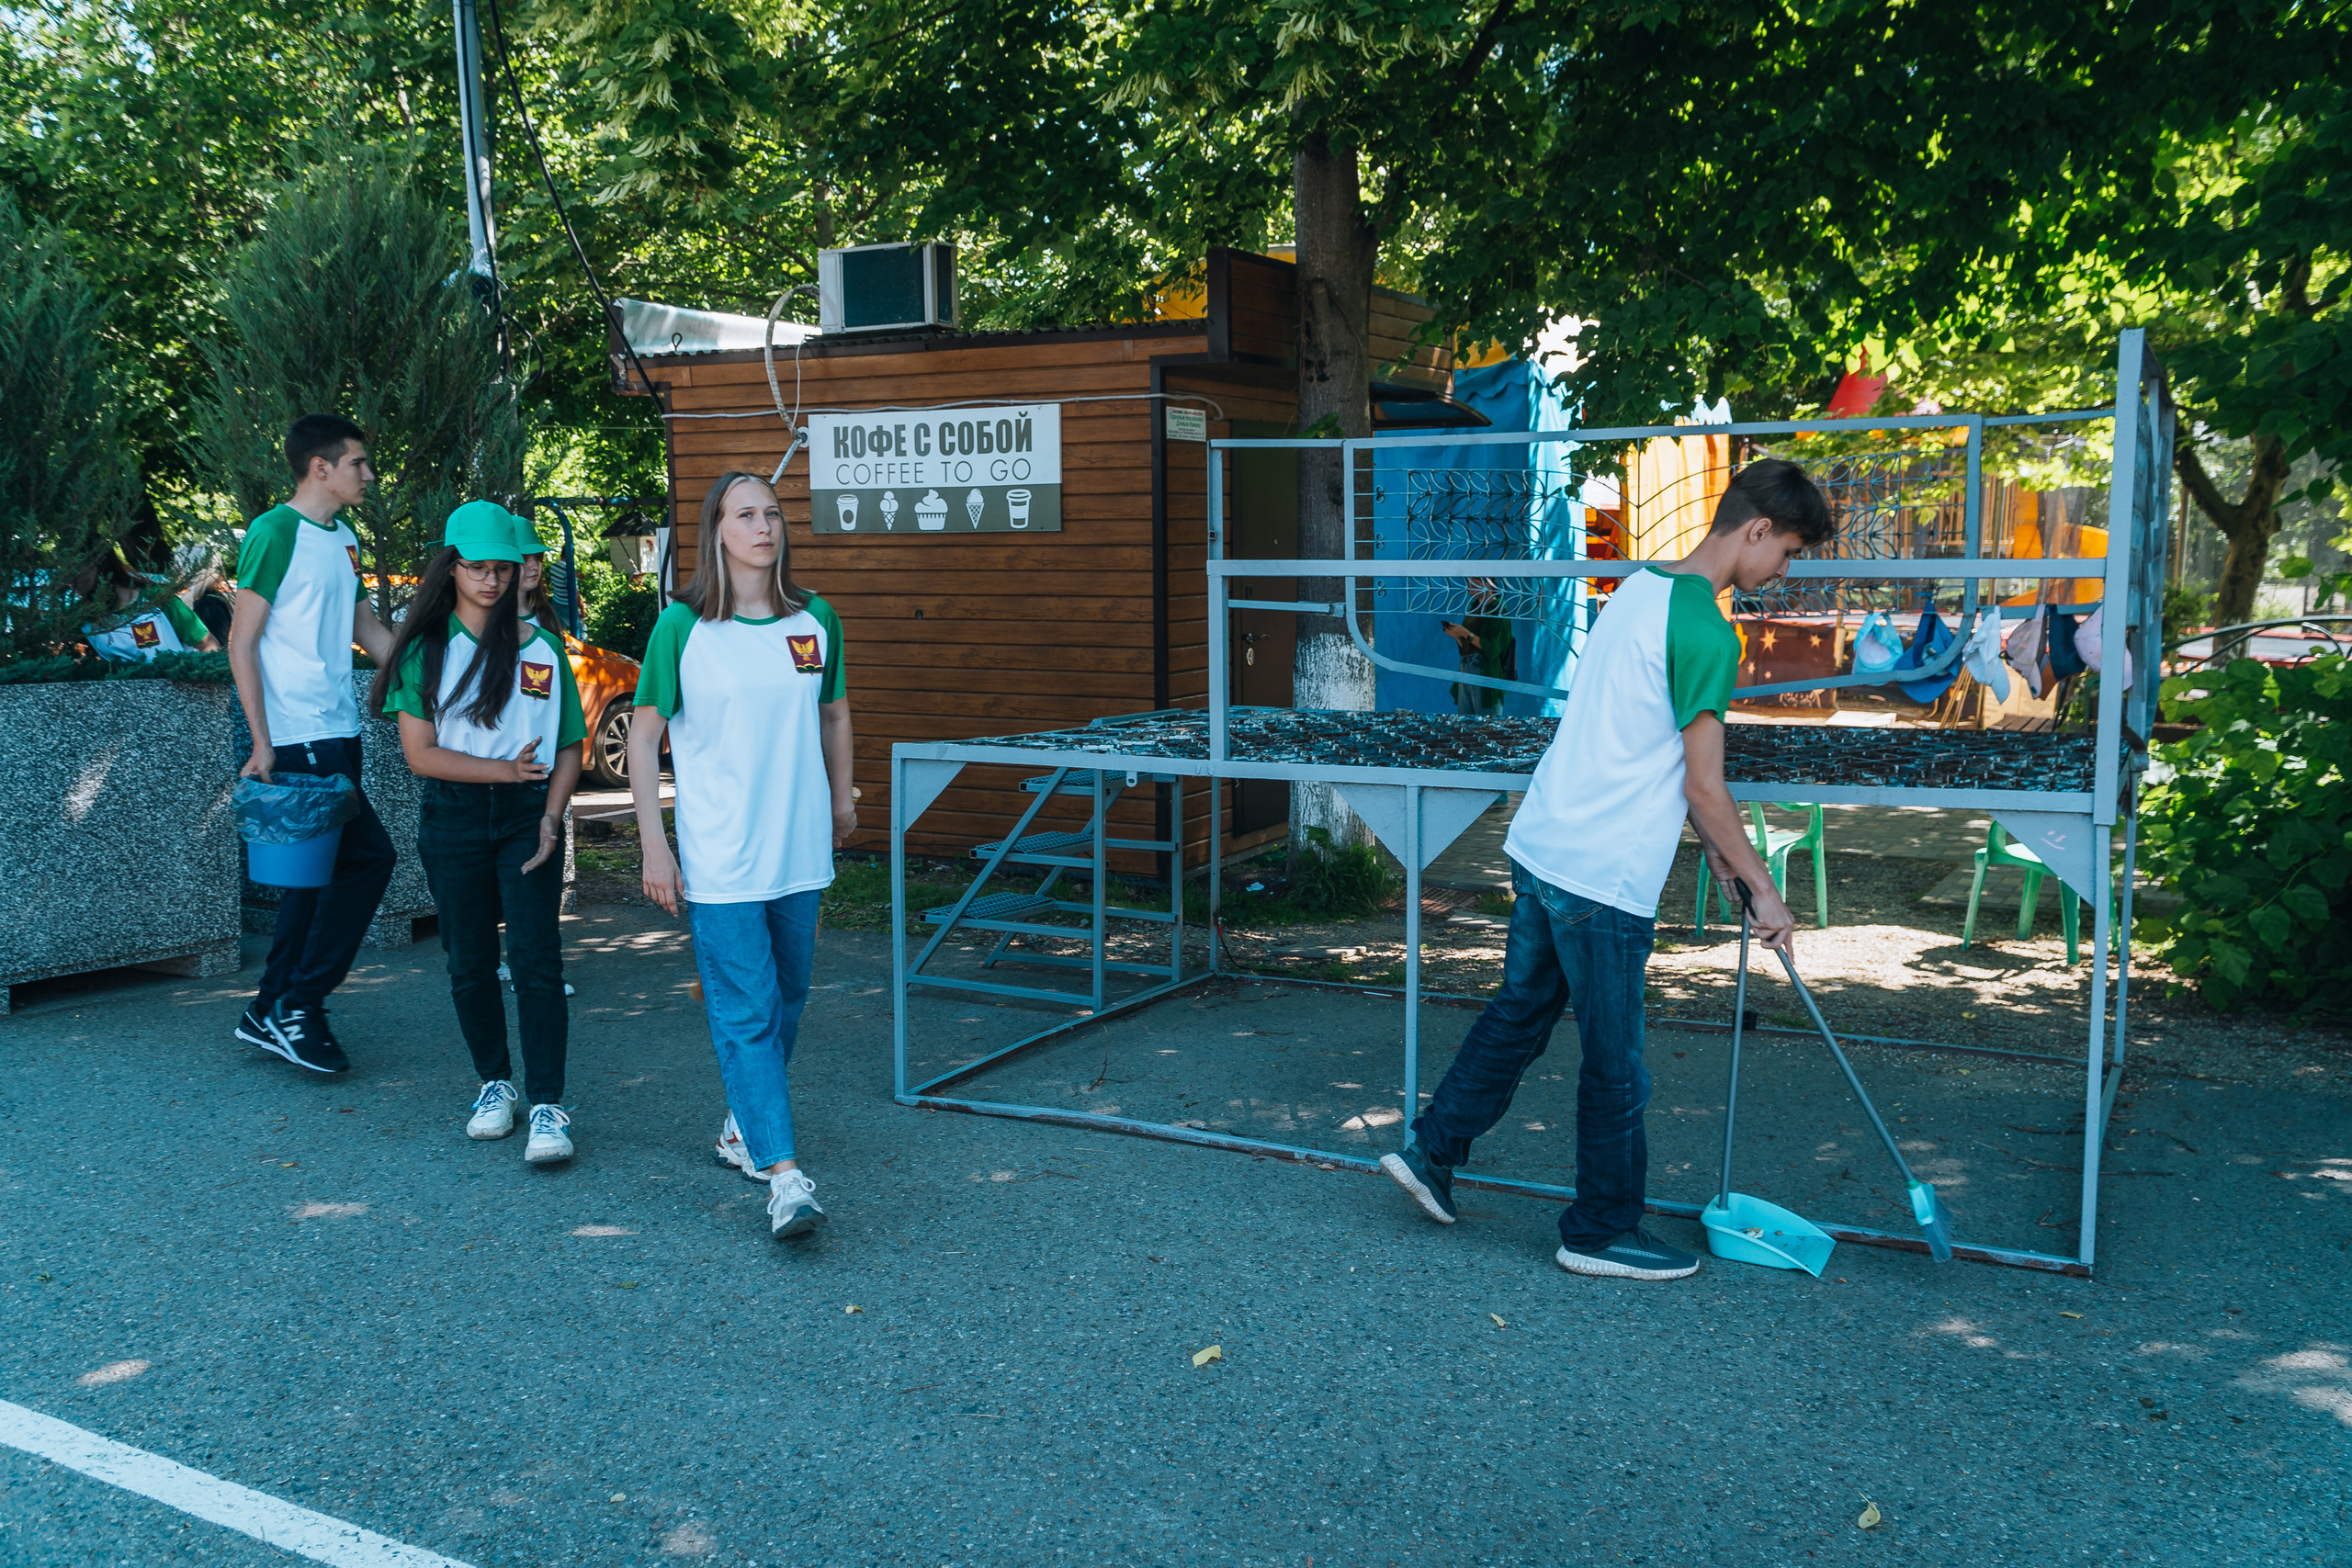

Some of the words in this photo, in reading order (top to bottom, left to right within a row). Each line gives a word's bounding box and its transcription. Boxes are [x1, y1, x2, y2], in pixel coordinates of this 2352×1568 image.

[833, 423, 907, 458] КОФЕ
[914, 423, 931, 457] С
[939, 411, 1033, 456] СОБОЙ
[836, 462, 924, 485] COFFEE
[940, 460, 973, 483] TO
[989, 458, 1031, 481] GO
